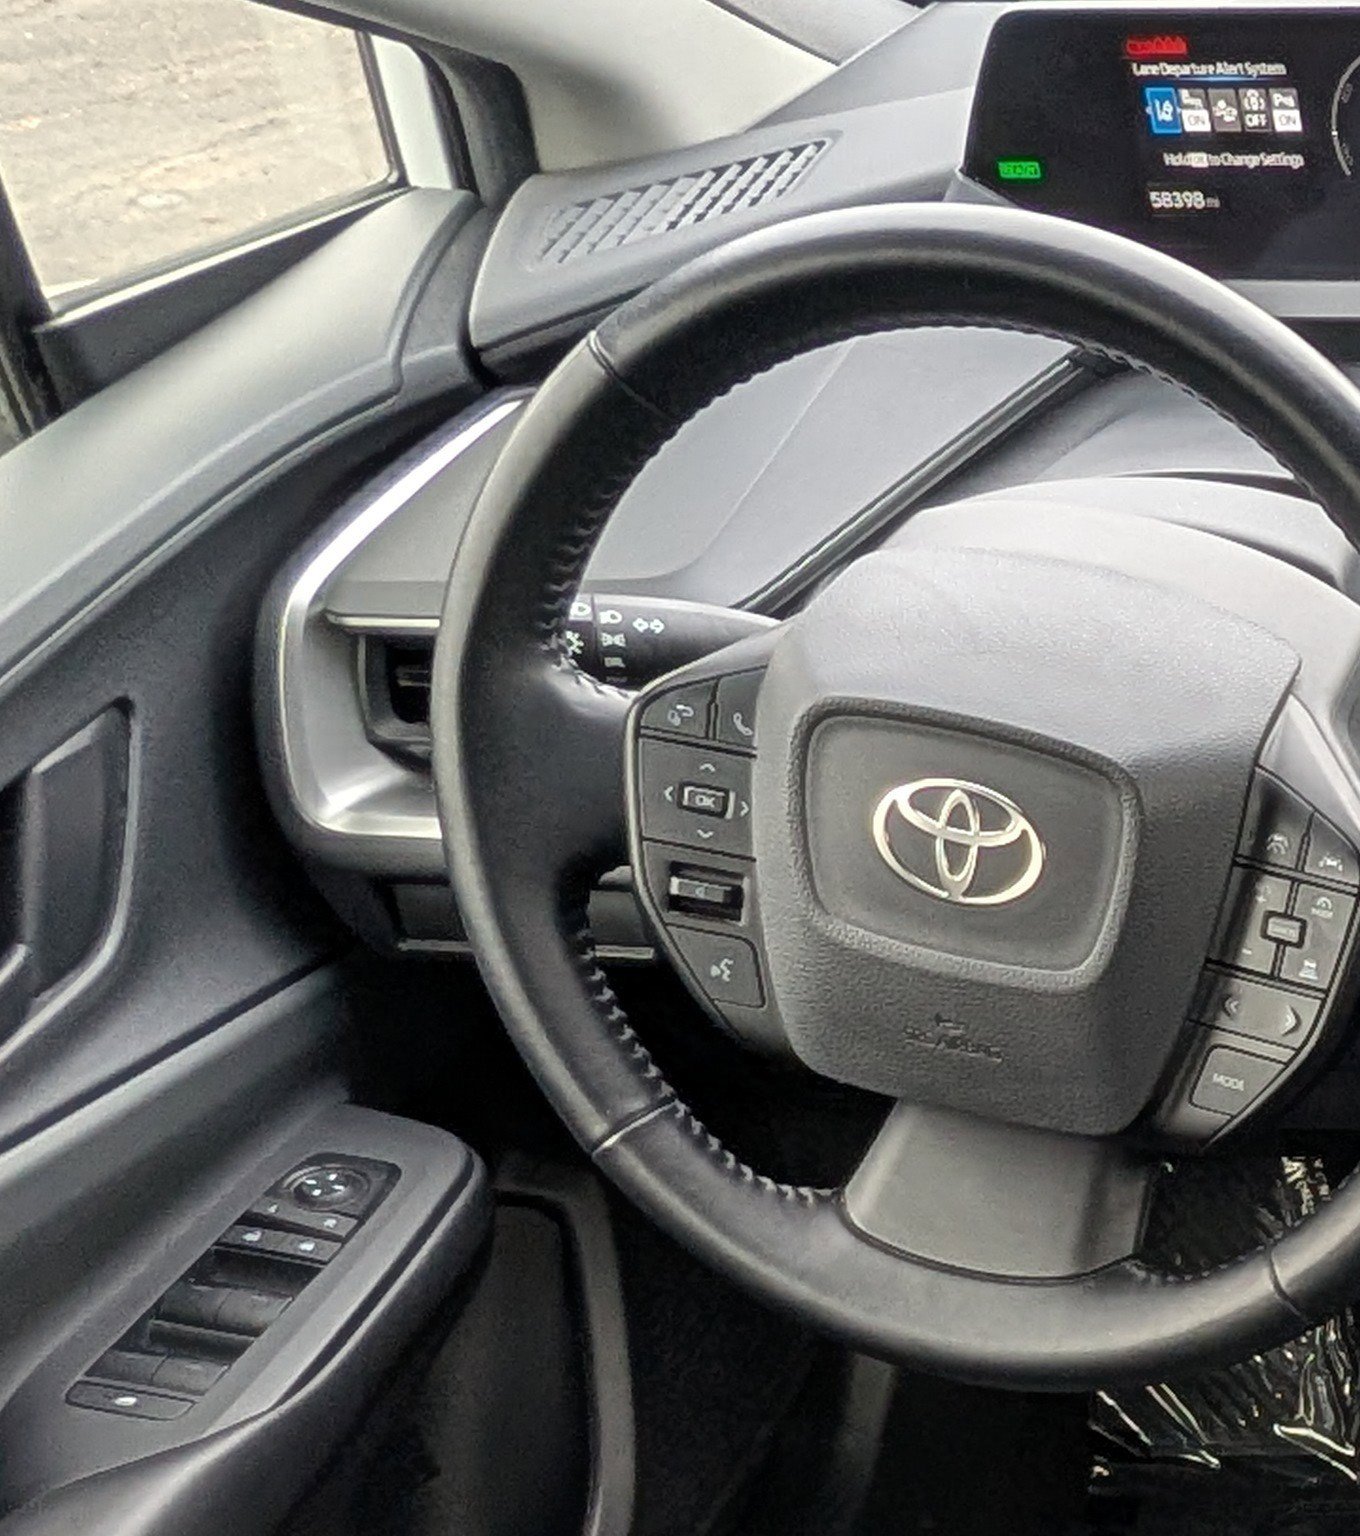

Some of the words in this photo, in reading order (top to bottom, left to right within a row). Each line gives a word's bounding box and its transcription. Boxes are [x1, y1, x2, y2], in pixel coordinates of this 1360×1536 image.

[1160, 62, 1214, 78] Departure
[1244, 61, 1287, 78] System
[1245, 114, 1267, 127] OFF
[1150, 191, 1205, 208] 58398
[695, 794, 715, 808] OK
